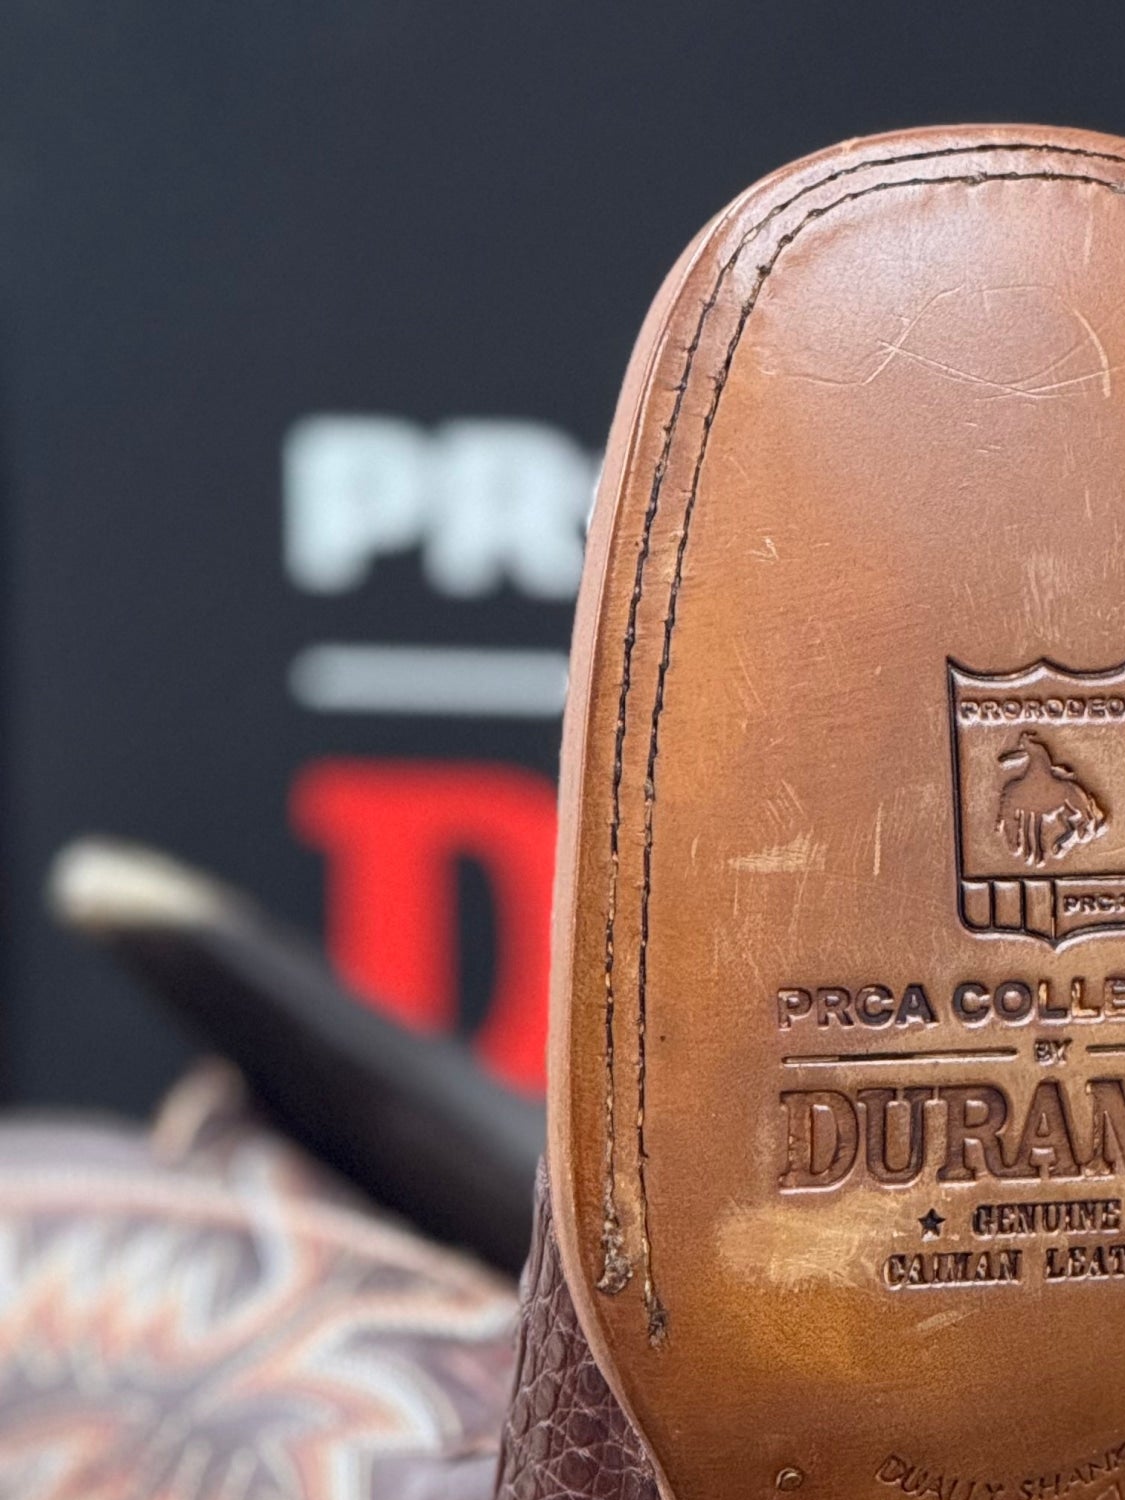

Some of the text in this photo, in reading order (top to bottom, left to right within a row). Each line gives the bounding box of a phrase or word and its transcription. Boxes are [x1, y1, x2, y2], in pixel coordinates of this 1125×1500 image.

[284, 414, 603, 598] PR
[777, 983, 940, 1031] PRCA
[1033, 1038, 1072, 1066] BY
[972, 1199, 1121, 1240] GENUINE
[883, 1250, 1022, 1291] CAIMAN
